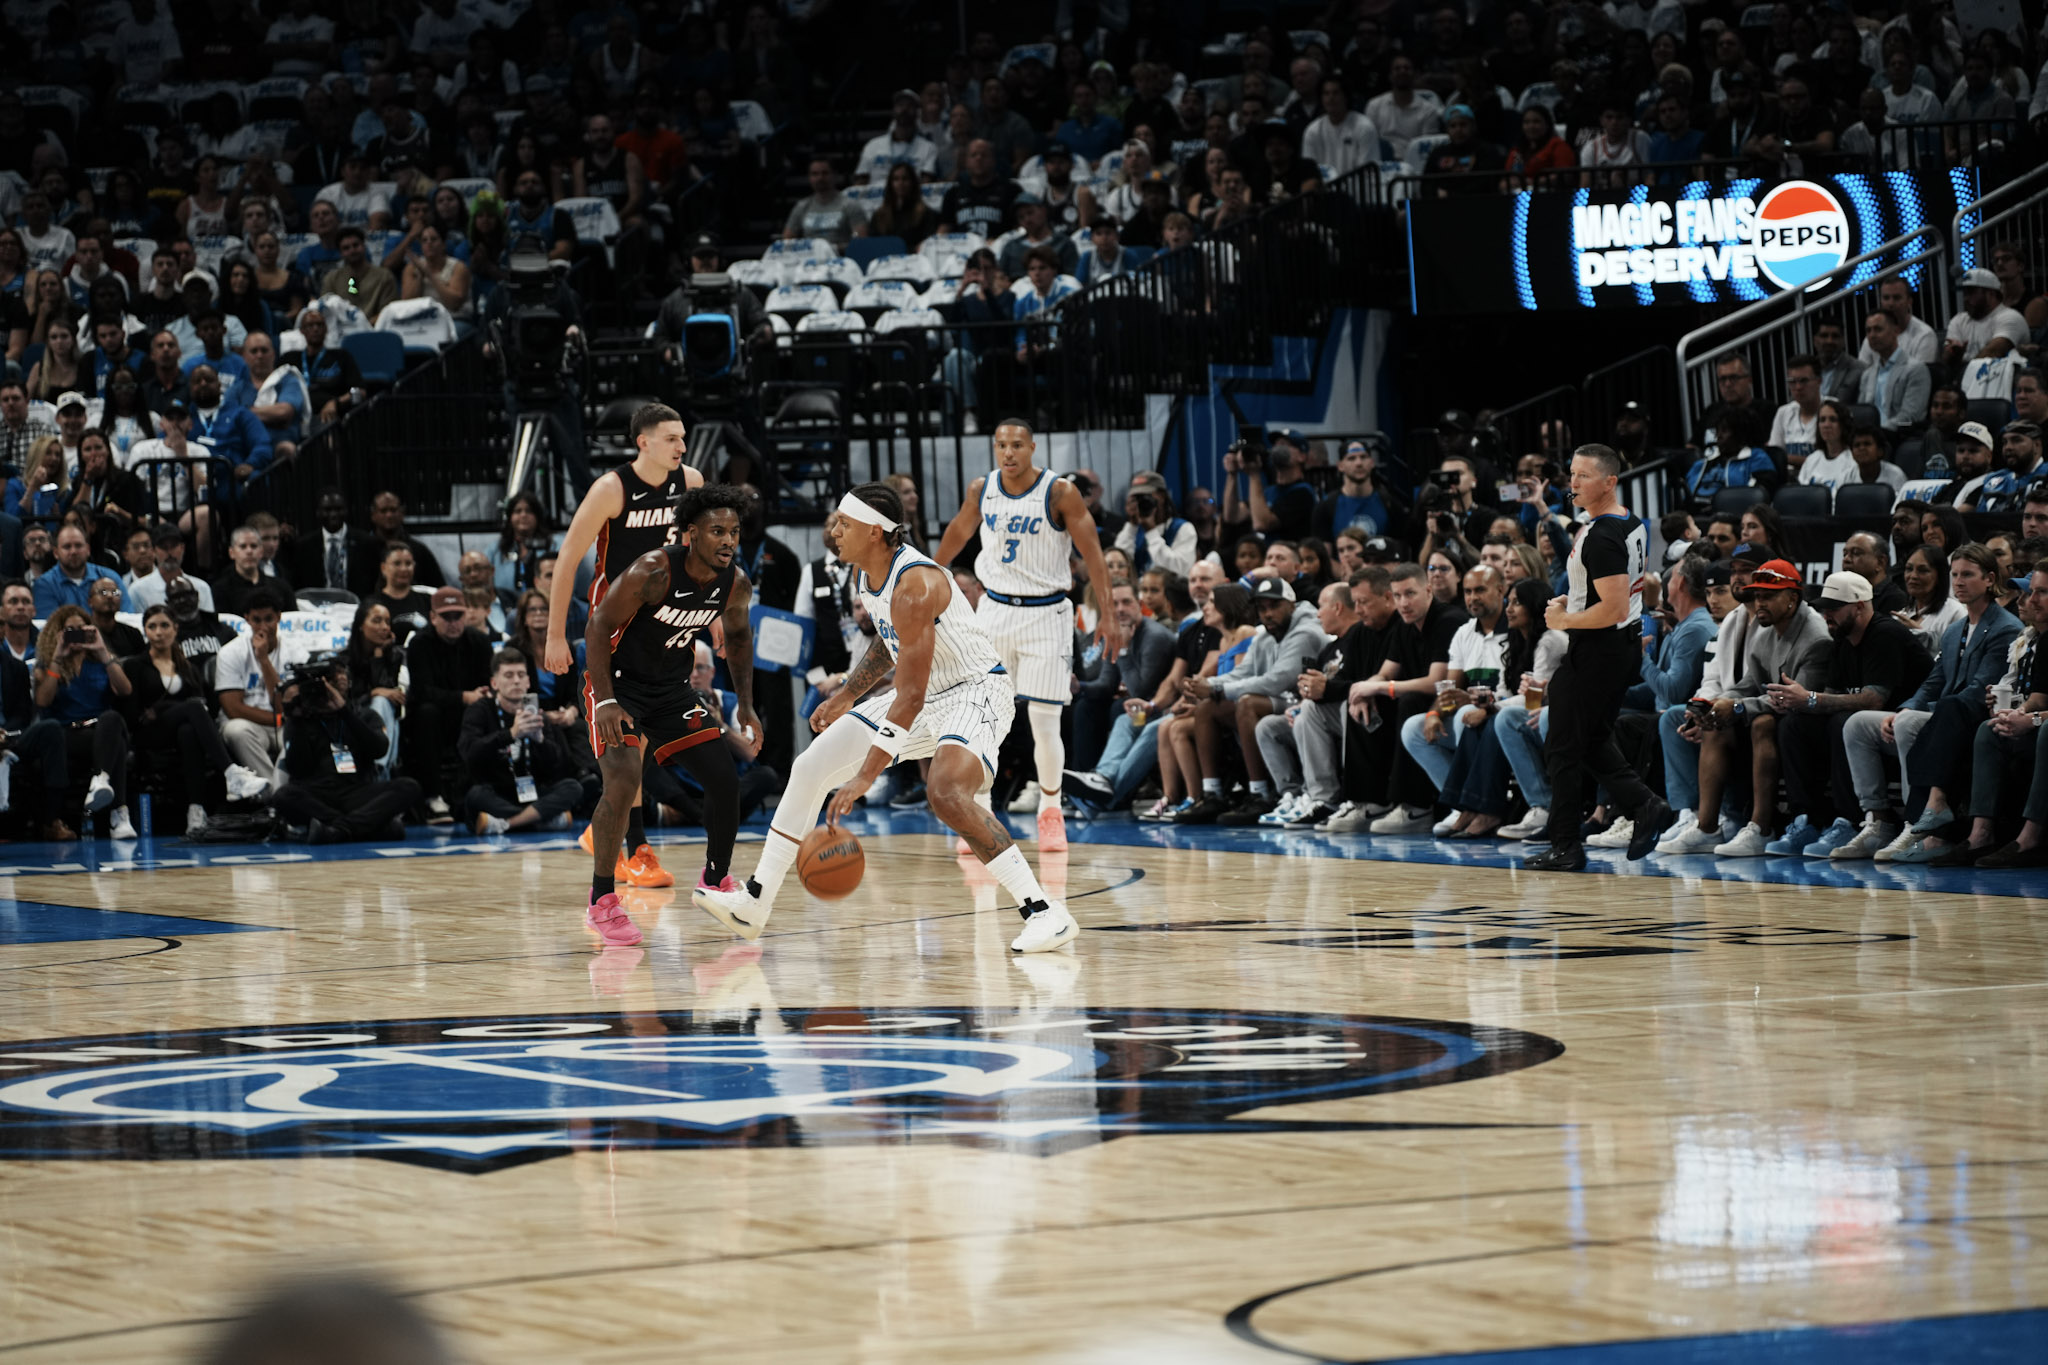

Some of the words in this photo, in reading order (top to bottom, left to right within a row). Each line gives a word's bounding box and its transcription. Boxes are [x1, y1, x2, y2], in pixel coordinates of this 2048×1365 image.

[1573, 200, 1672, 249] MAGIC
[1676, 196, 1757, 243] FANS
[1761, 224, 1841, 248] PEPSI
[1578, 243, 1759, 287] DESERVE
[625, 506, 679, 529] MIAM
[1001, 538, 1020, 564] 3
[653, 604, 719, 628] MIAMI
[665, 627, 701, 649] 45
